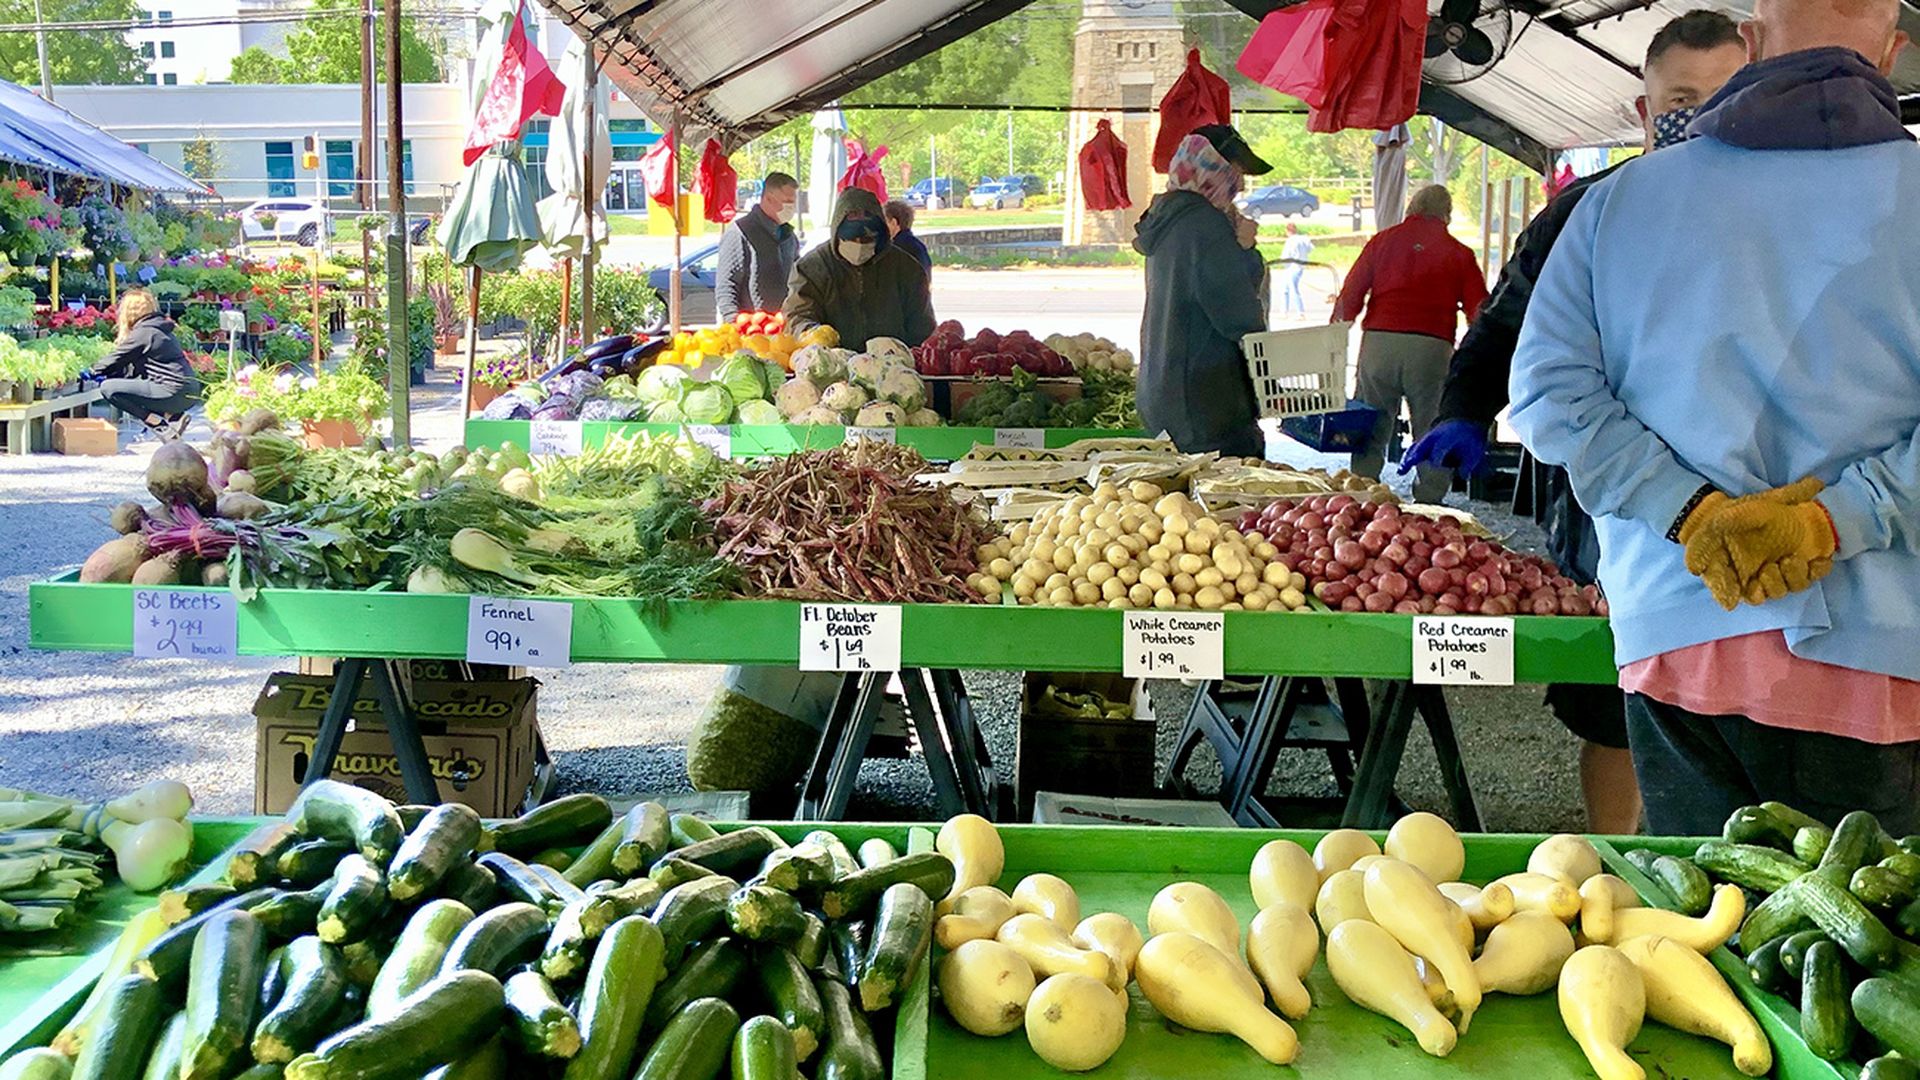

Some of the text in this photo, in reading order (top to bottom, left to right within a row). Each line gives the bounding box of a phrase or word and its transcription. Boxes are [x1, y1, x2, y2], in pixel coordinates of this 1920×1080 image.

[137, 591, 221, 611] SC Beets
[481, 603, 535, 621] Fennel
[826, 606, 878, 624] October
[826, 622, 872, 637] Beans
[1129, 617, 1222, 632] White Creamer
[1419, 621, 1509, 638] Red Creamer
[1141, 632, 1195, 646] Potatoes
[1428, 638, 1487, 653] Potatoes
[191, 642, 227, 655] bunch
